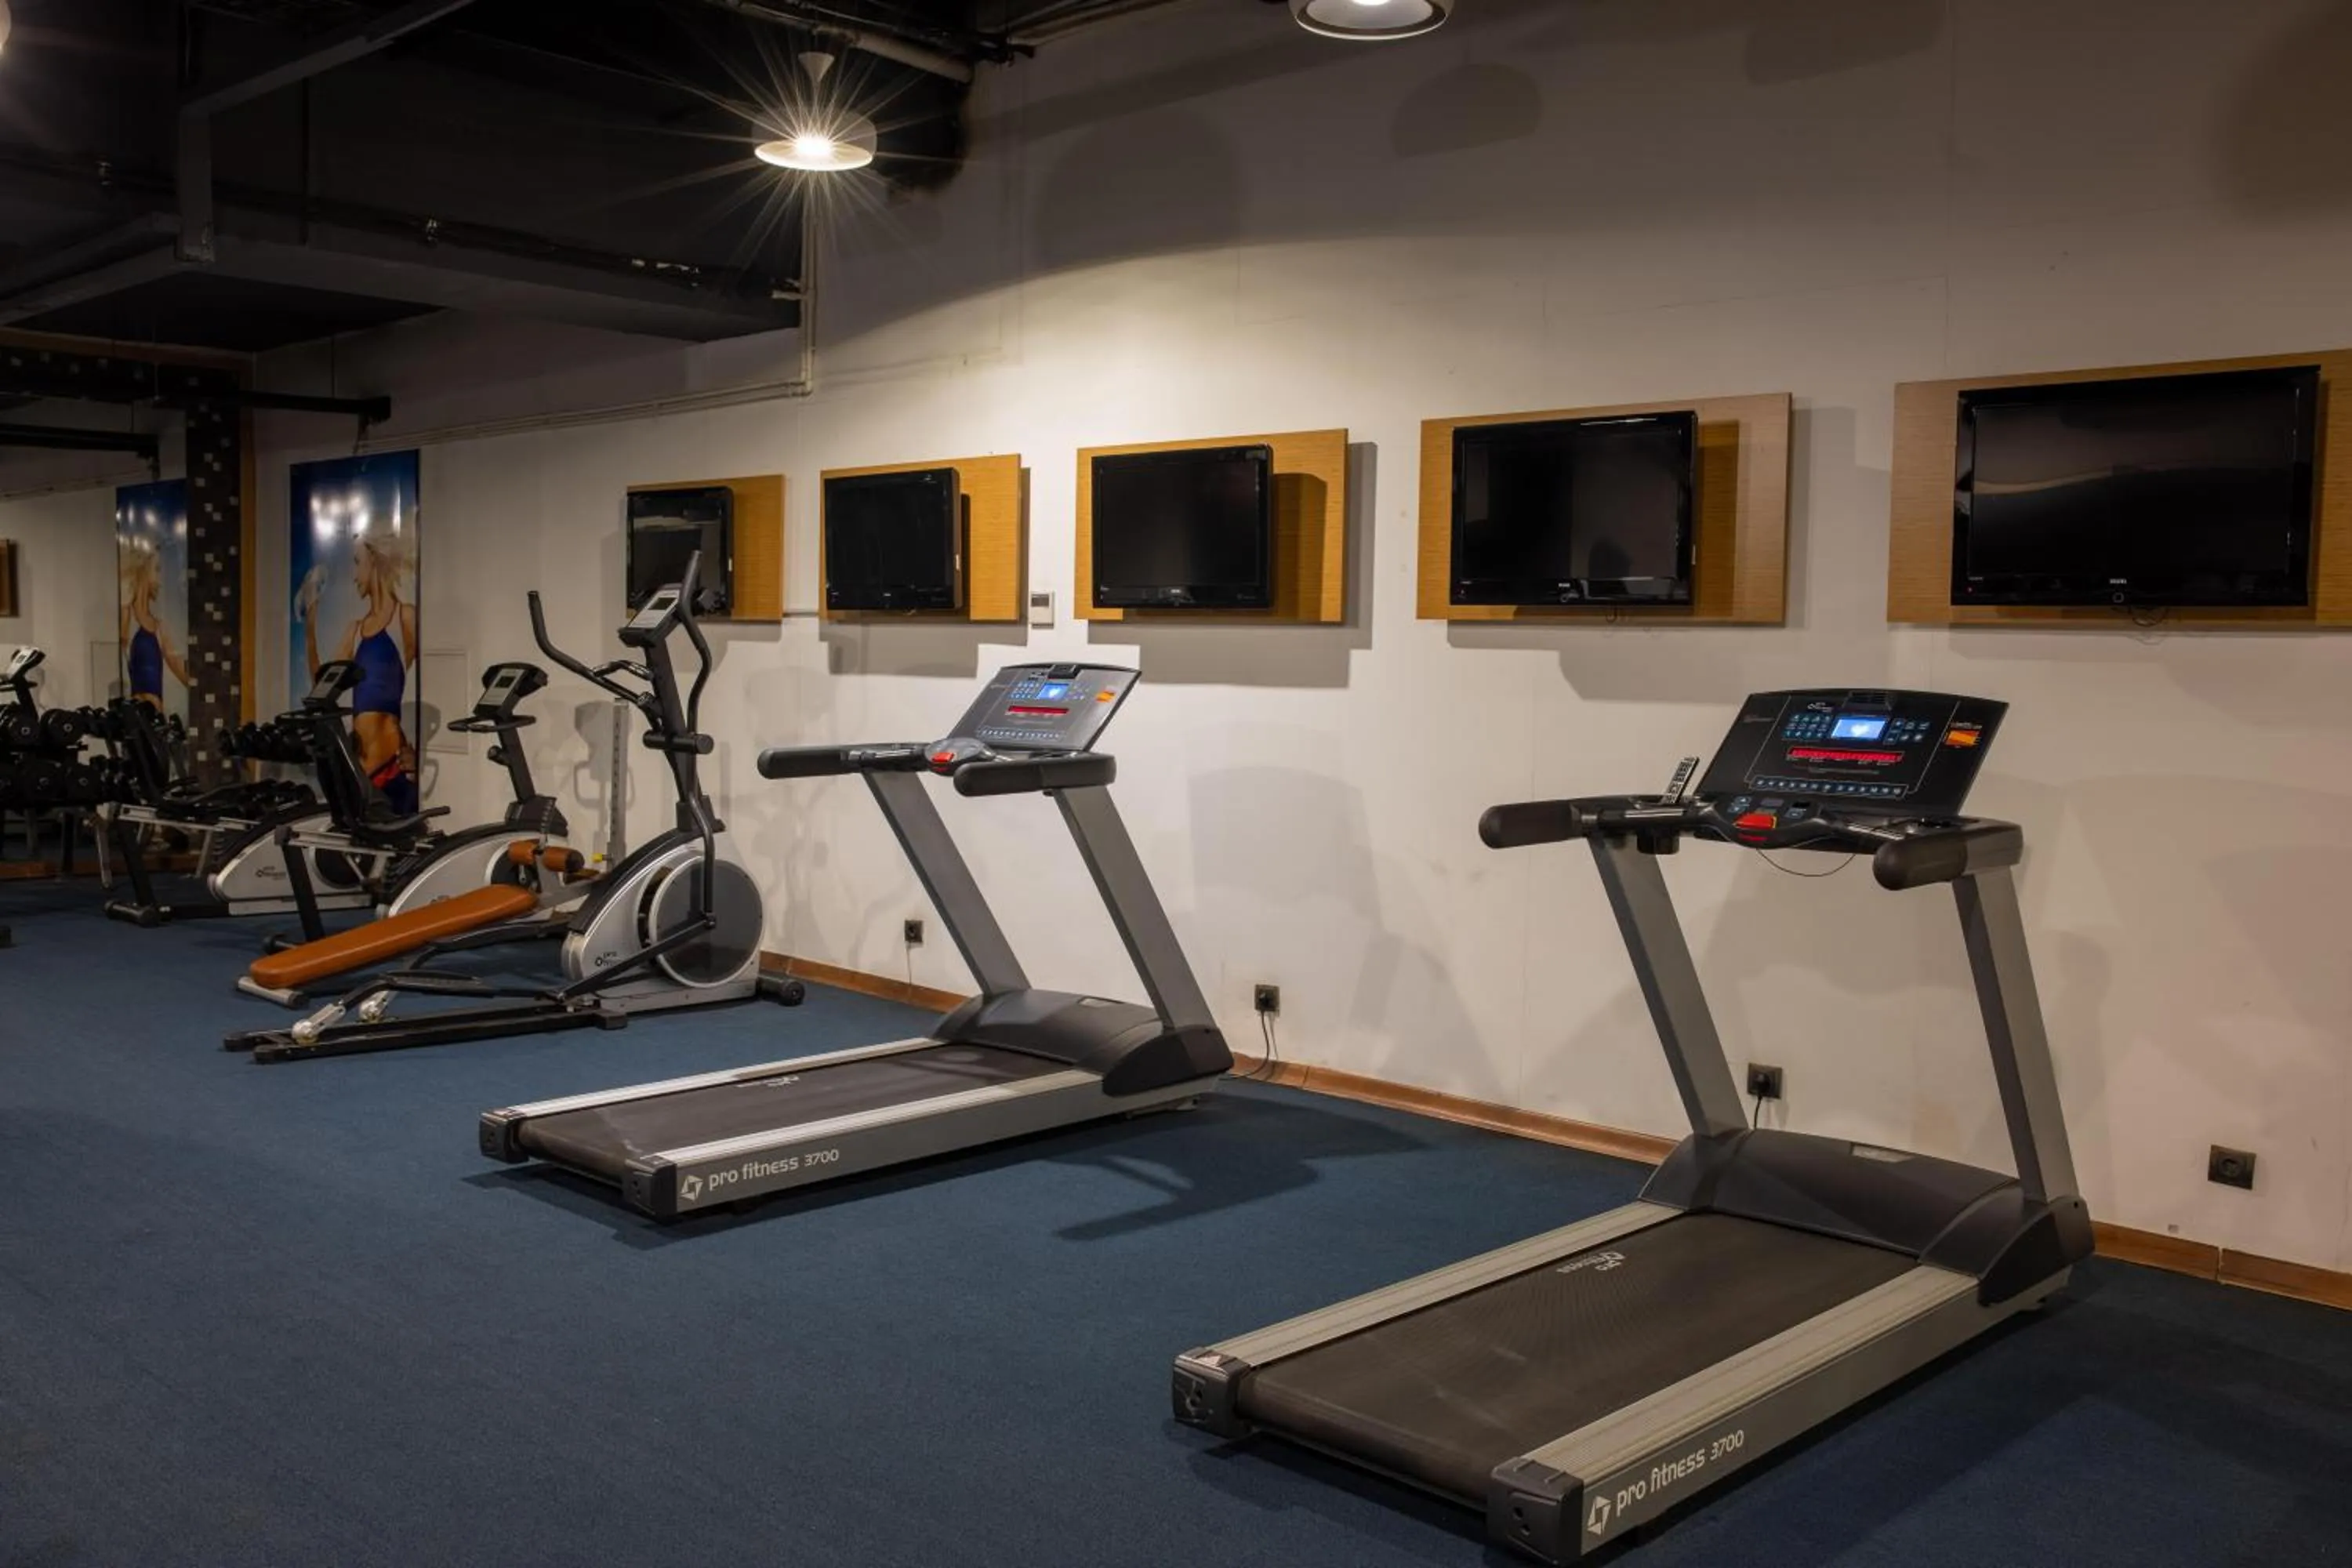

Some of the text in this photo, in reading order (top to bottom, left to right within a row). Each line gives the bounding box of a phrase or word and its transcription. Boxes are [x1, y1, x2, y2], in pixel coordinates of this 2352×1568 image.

[709, 1149, 840, 1191] pro fitness 3700
[1616, 1429, 1744, 1518] pro fitness 3700
